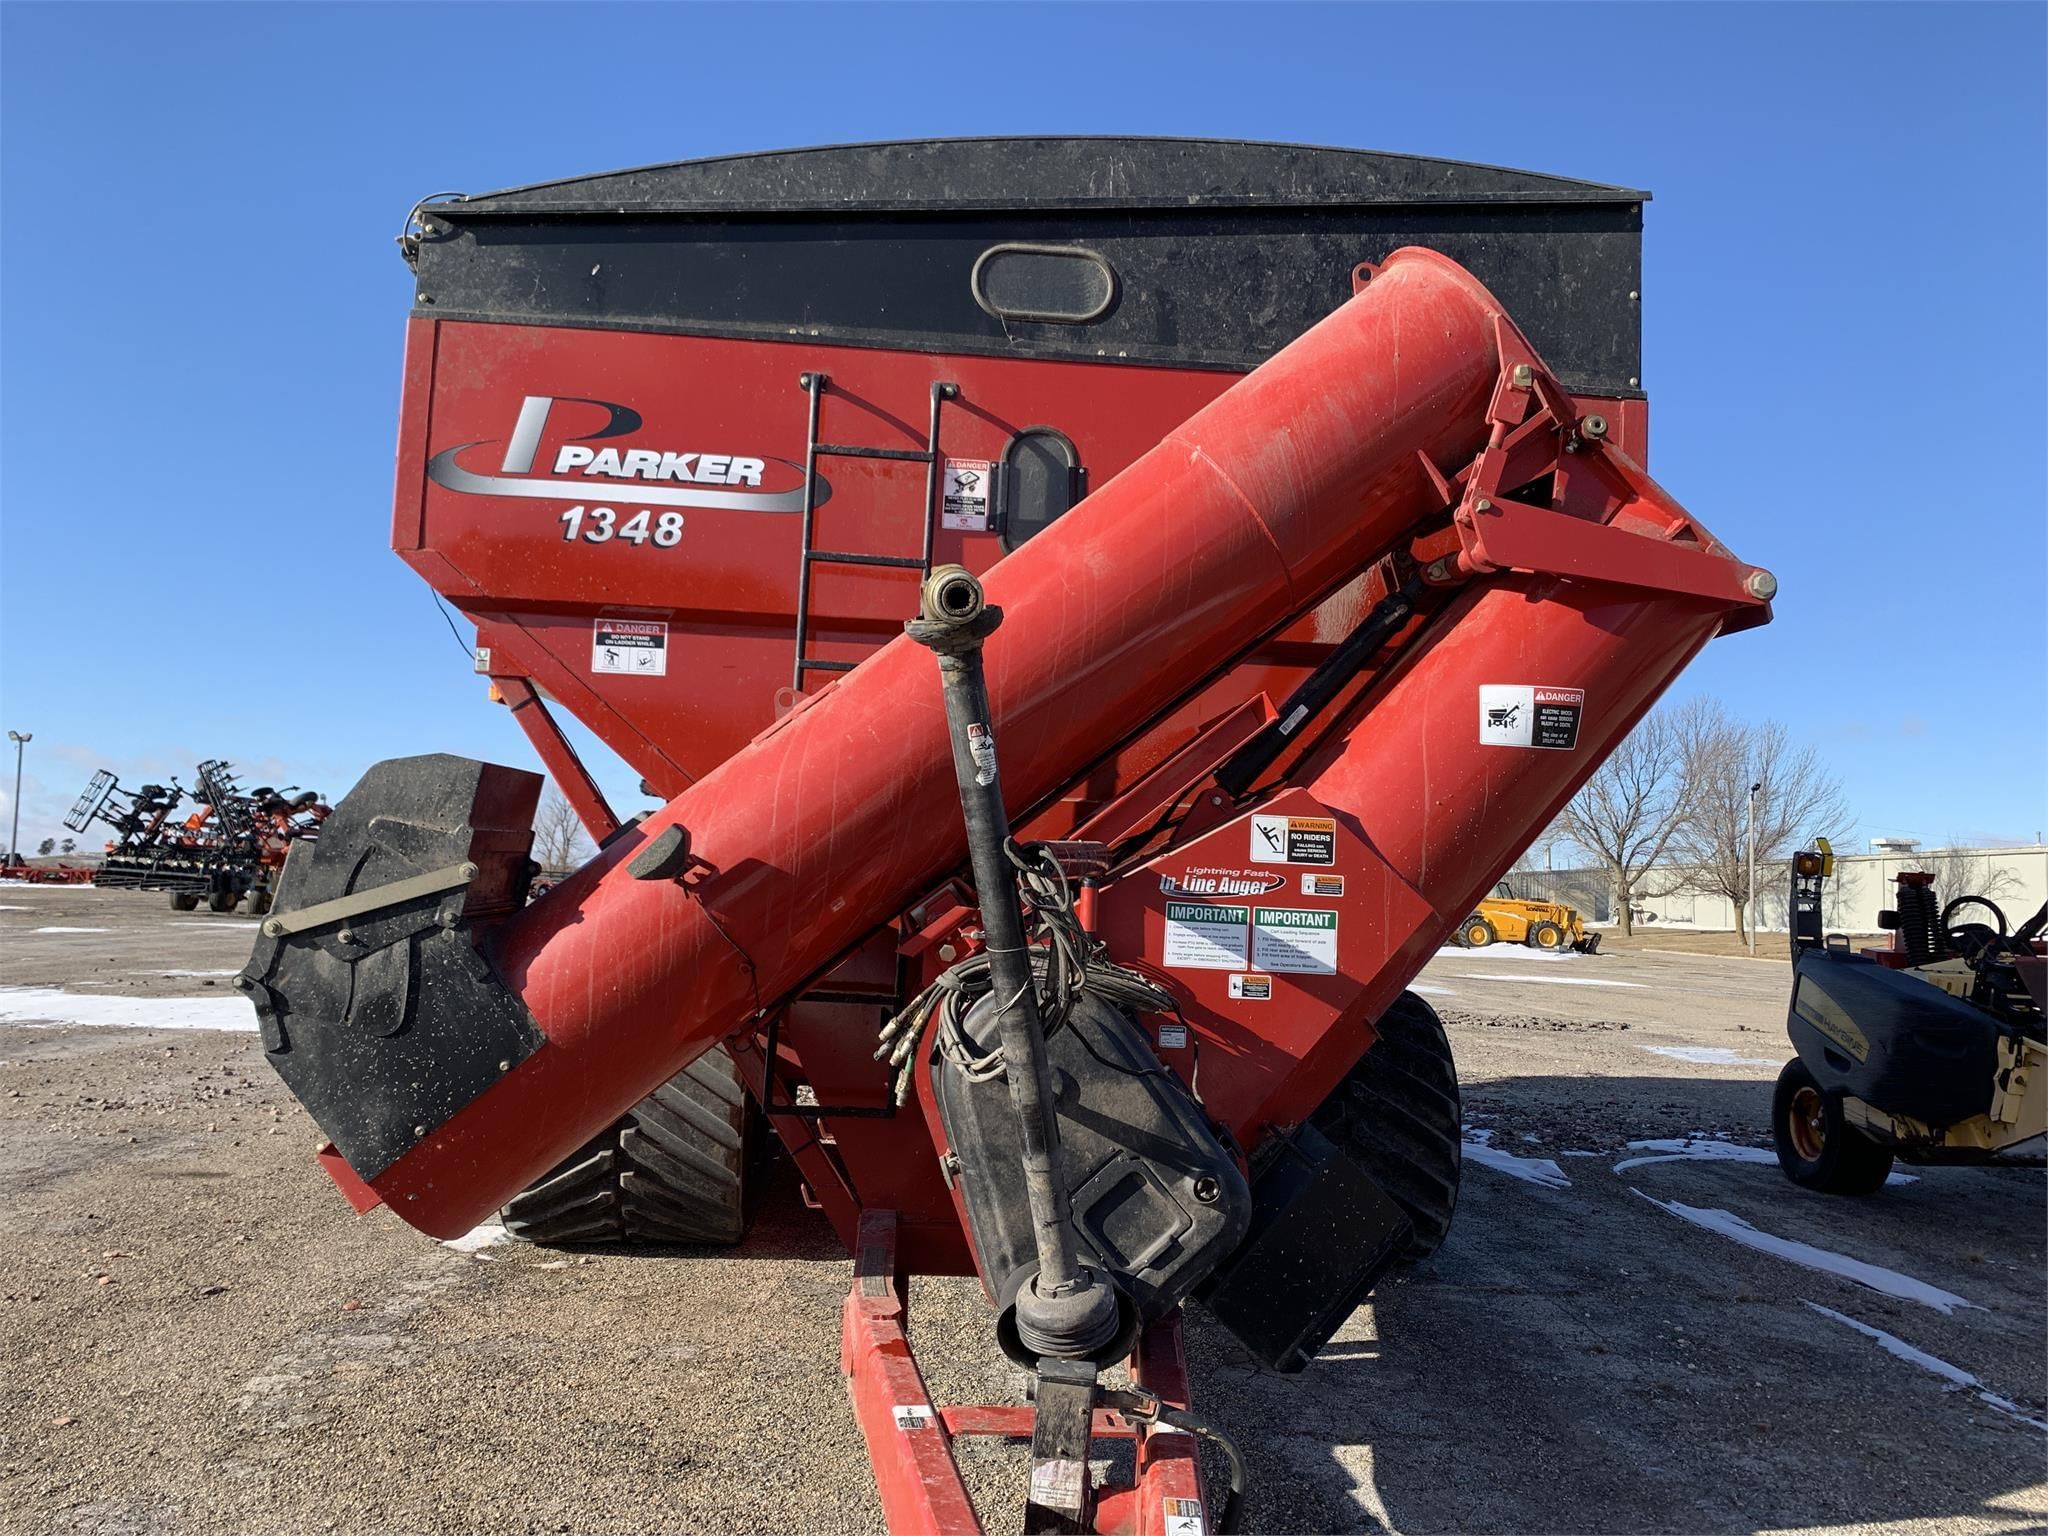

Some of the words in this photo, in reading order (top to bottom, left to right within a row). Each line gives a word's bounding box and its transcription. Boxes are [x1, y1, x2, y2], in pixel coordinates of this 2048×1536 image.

[552, 445, 765, 486] PARKER
[956, 461, 987, 470] DANGER
[559, 505, 684, 548] 1348
[617, 624, 659, 633] DANGER
[1545, 693, 1581, 703] DANGER
[1186, 866, 1240, 877] Lightning
[1160, 874, 1216, 892] In-Line
[1218, 877, 1268, 896] Auger
[1170, 906, 1244, 922] IMPORTANT
[1260, 911, 1331, 926] IMPORTANT
